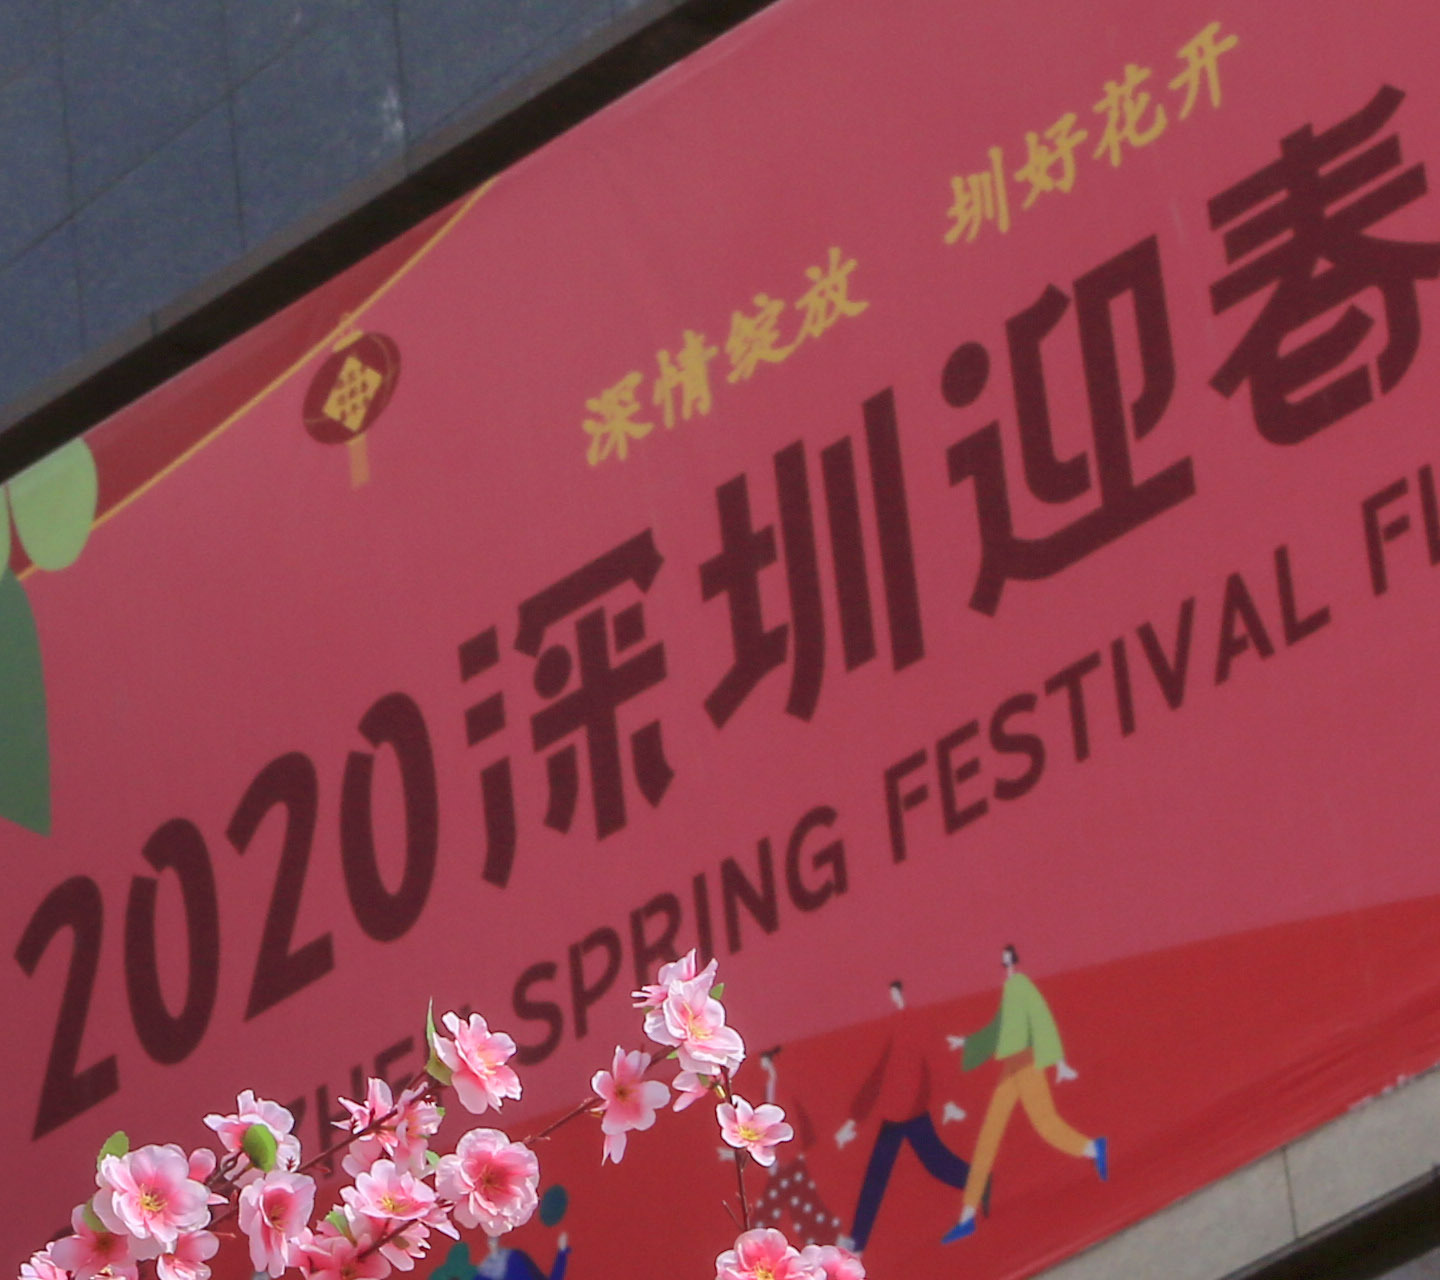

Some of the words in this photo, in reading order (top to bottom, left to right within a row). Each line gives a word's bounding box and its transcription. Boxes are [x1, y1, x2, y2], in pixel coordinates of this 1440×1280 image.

[582, 247, 869, 465] 深情绽放
[944, 22, 1238, 244] 圳好花开
[511, 805, 849, 1067] SPRING
[884, 546, 1331, 863] FESTIVAL
